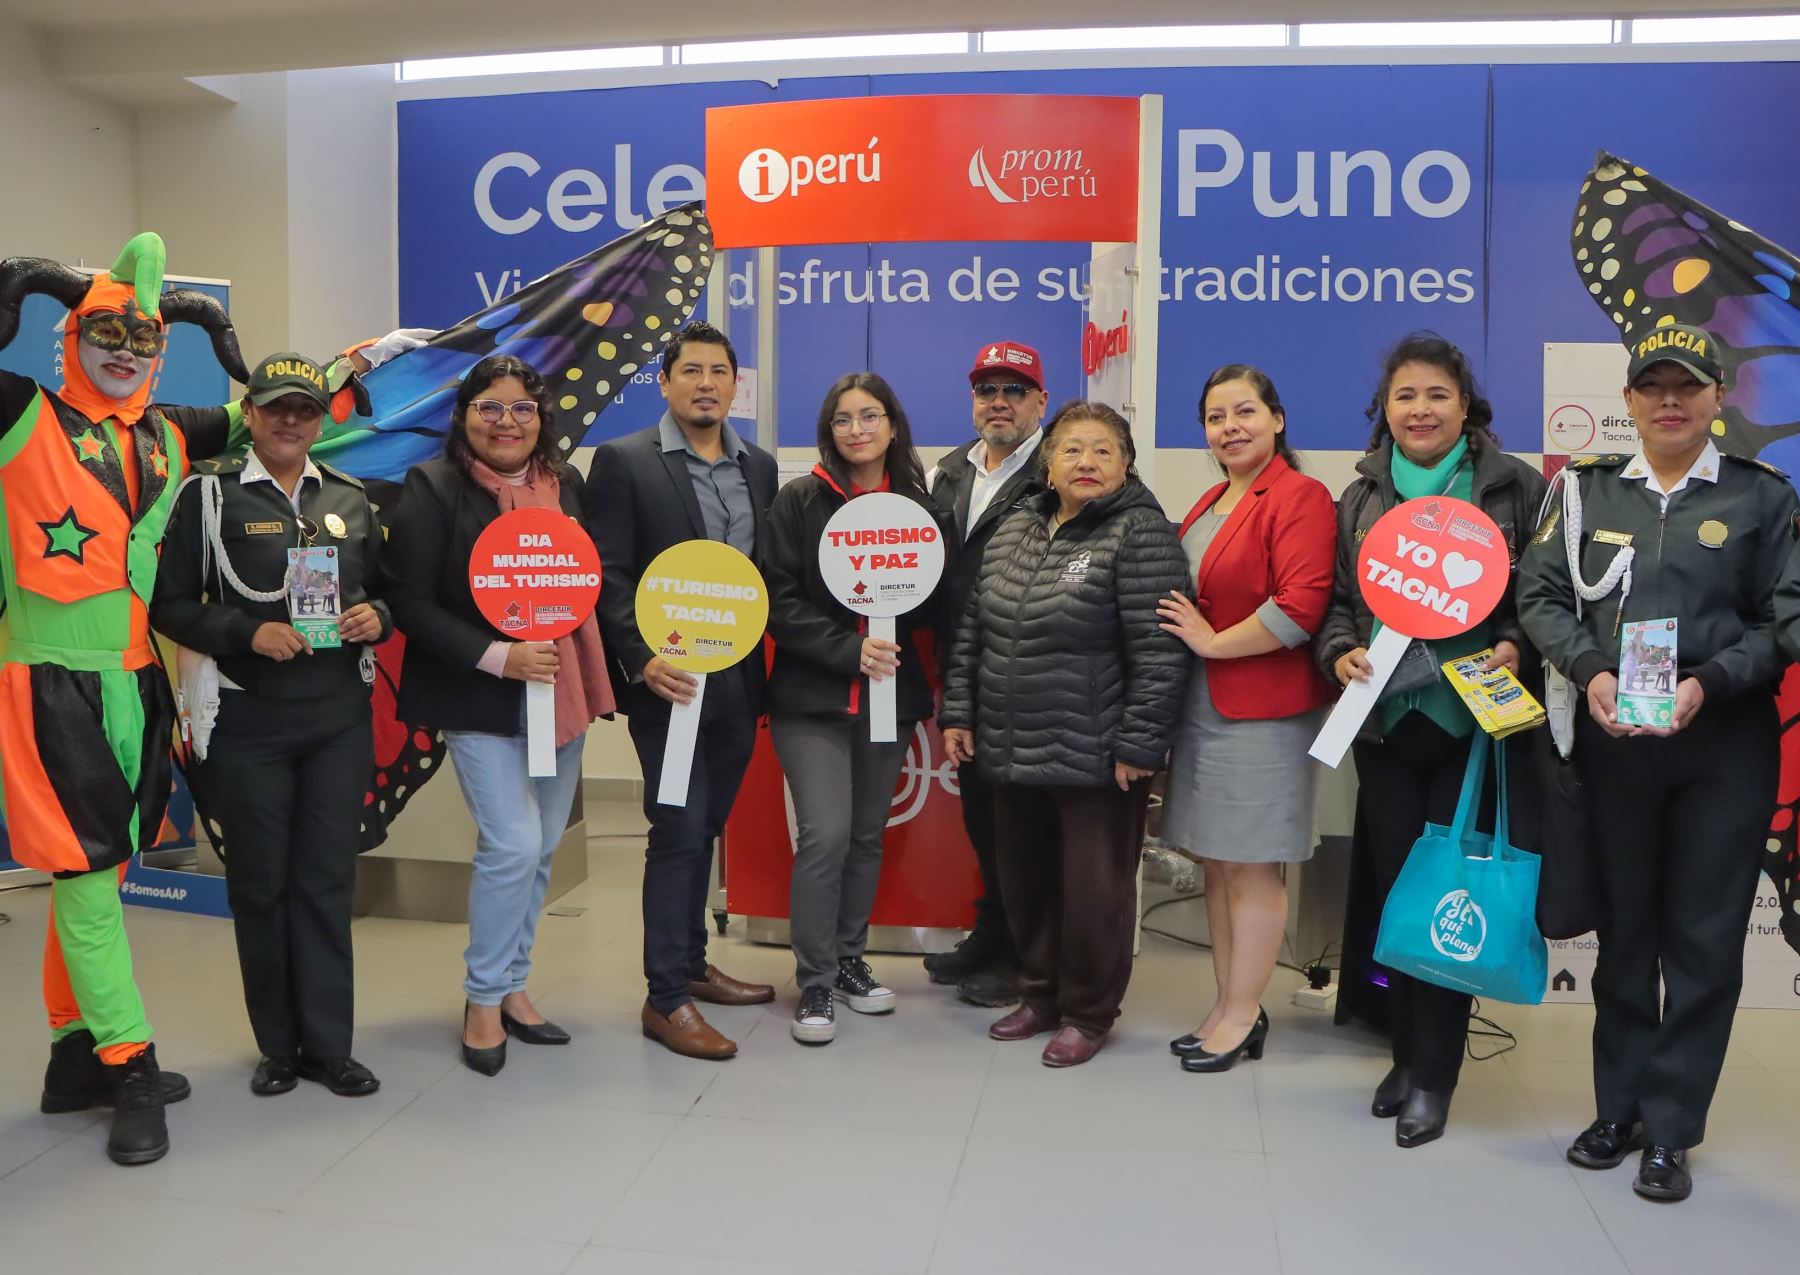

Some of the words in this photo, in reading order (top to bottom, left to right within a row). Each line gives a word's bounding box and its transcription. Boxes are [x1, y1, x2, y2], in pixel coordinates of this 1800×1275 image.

[1000, 146, 1083, 179] prom
[1177, 129, 1471, 219] Puno
[1021, 168, 1098, 203] perú
[729, 258, 930, 305] dsfruta
[948, 256, 1021, 302] de
[1158, 254, 1475, 303] tradiciones
[1638, 330, 1706, 359] POLICIA
[265, 360, 324, 390] POLICIA
[1602, 431, 1635, 442] Tacna,
[519, 534, 552, 547] DIA
[828, 527, 937, 547] TURISMO
[1396, 534, 1437, 568] YO
[493, 554, 579, 568] MUNDIAL
[849, 555, 865, 571] Y
[871, 553, 918, 570] PAZ
[474, 575, 511, 588] DEL
[513, 573, 600, 588] TURISMO
[646, 576, 759, 602] #TURISMO
[880, 583, 916, 591] DIRCETUR
[847, 597, 874, 605] TACNA
[1366, 558, 1469, 625] TACNA
[662, 604, 737, 626] TACNA
[658, 647, 687, 656] TACNA
[695, 638, 733, 647] DIRCETUR
[121, 881, 187, 900] #SomosAAP
[1440, 916, 1463, 934] qué
[1440, 932, 1478, 957] planes
[1550, 939, 1569, 949] Ver
